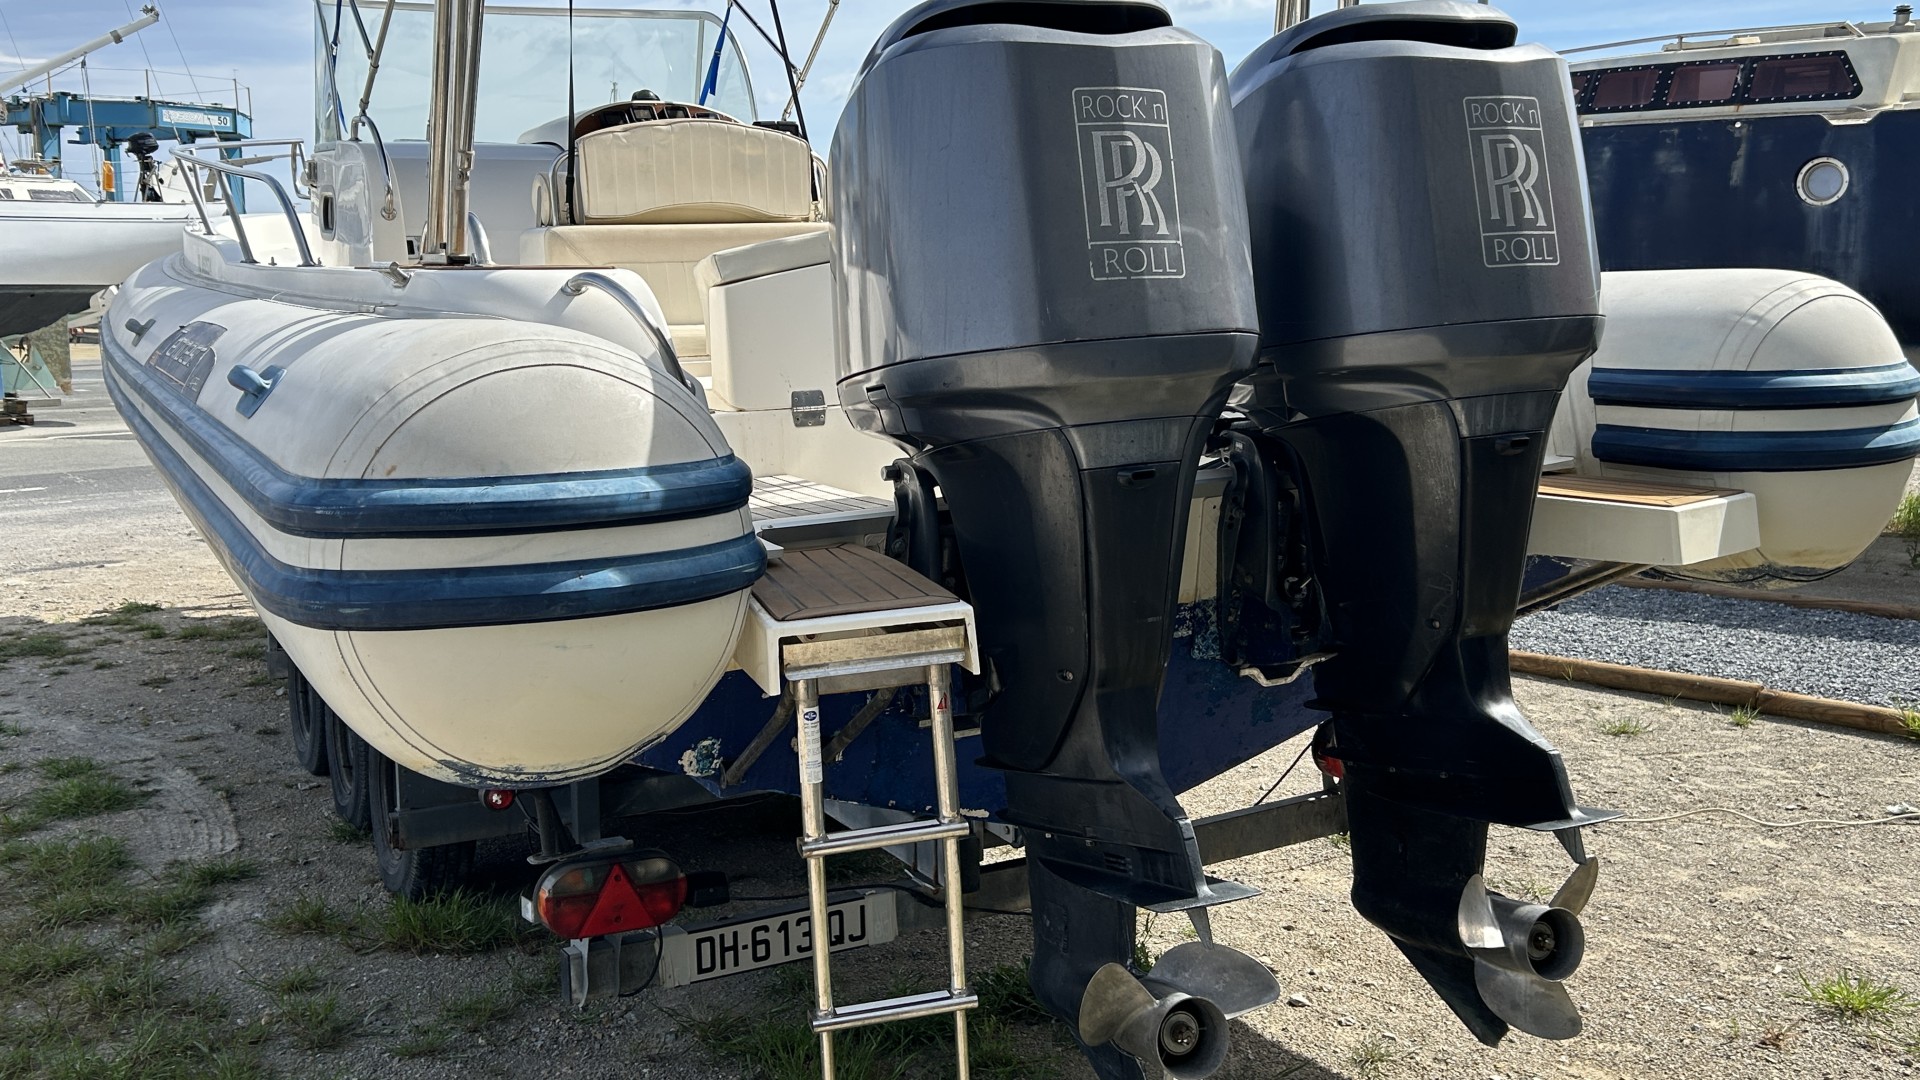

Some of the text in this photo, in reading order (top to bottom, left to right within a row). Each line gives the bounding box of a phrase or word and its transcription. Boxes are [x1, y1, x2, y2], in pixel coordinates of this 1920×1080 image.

[217, 116, 228, 126] 50
[1103, 246, 1177, 274] ROLL
[1493, 237, 1554, 262] ROLL
